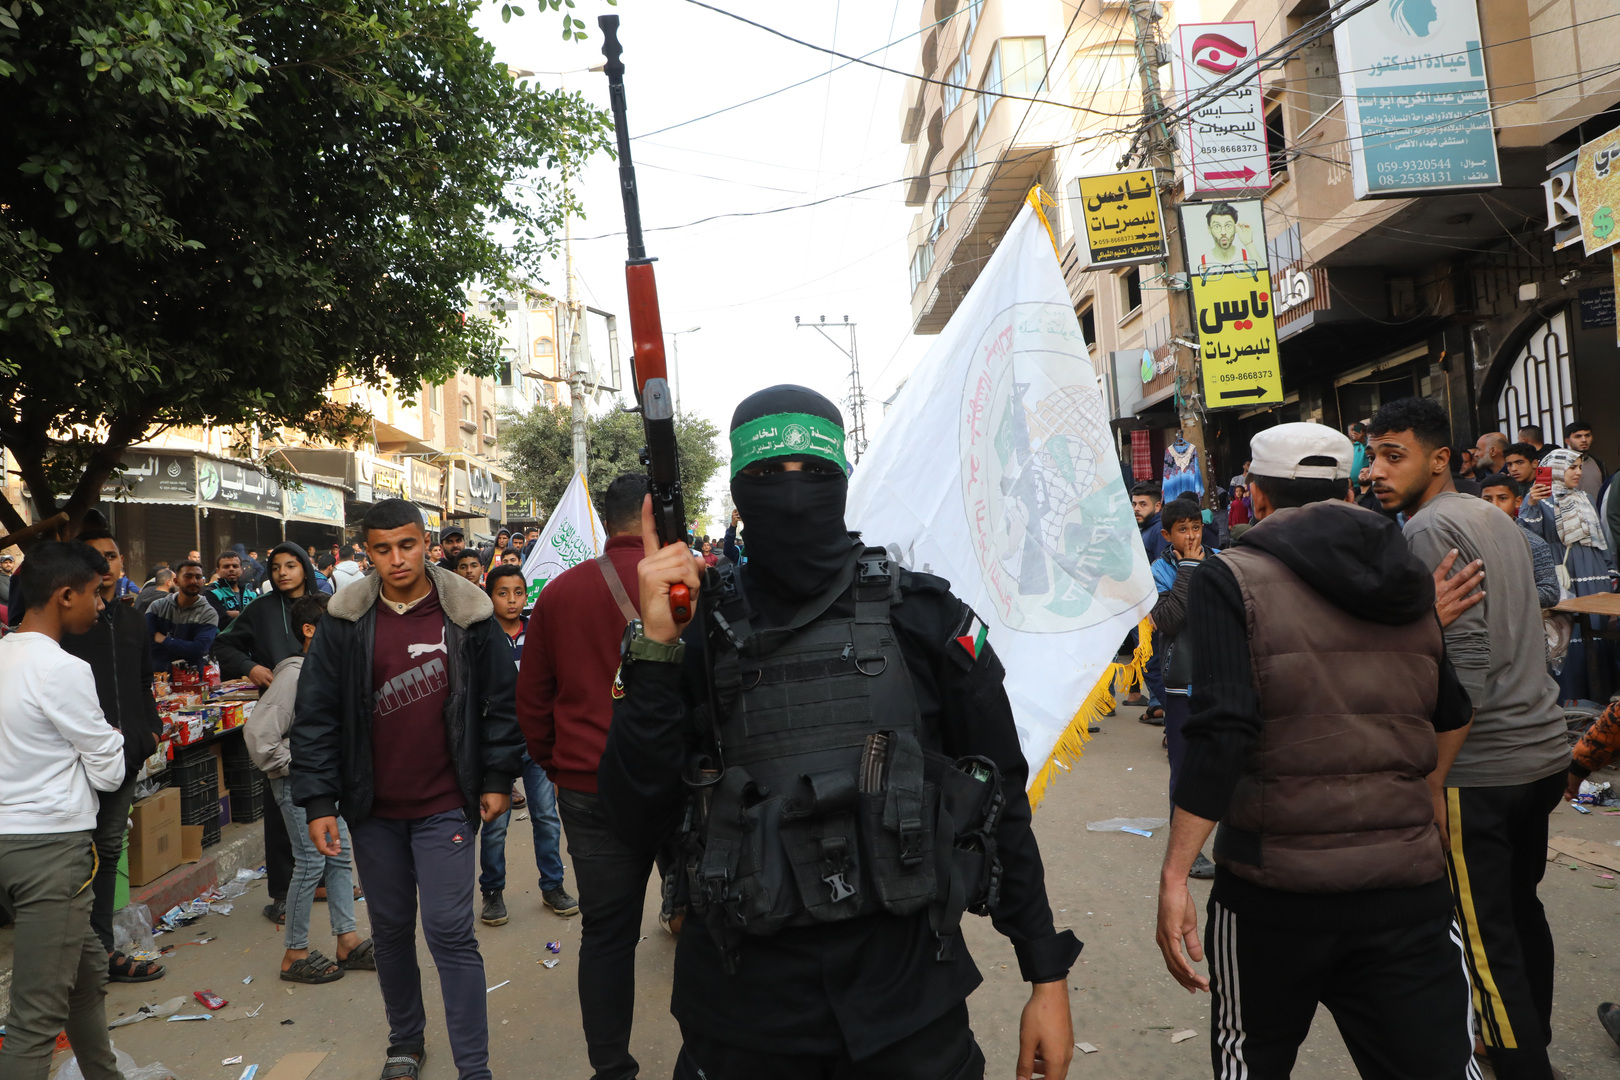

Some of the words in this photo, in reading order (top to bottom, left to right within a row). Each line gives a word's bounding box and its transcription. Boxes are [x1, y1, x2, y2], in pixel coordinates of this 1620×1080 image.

[1367, 54, 1422, 77] الدكتور
[1424, 53, 1467, 73] عيادة
[1396, 91, 1431, 108] الكريم
[1198, 103, 1254, 118] نايس
[1199, 121, 1256, 137] للبصريات
[1201, 144, 1258, 154] 059-8668373
[1377, 158, 1451, 173] 059-9320544
[1378, 171, 1452, 186] 08-2538131
[1088, 176, 1152, 212] نايس
[1091, 210, 1156, 234] للبصريات
[1098, 235, 1135, 245] 059-8668373
[1200, 290, 1269, 335] نايس
[1205, 336, 1271, 365] للبصريات
[1220, 370, 1273, 383] 059-8668373
